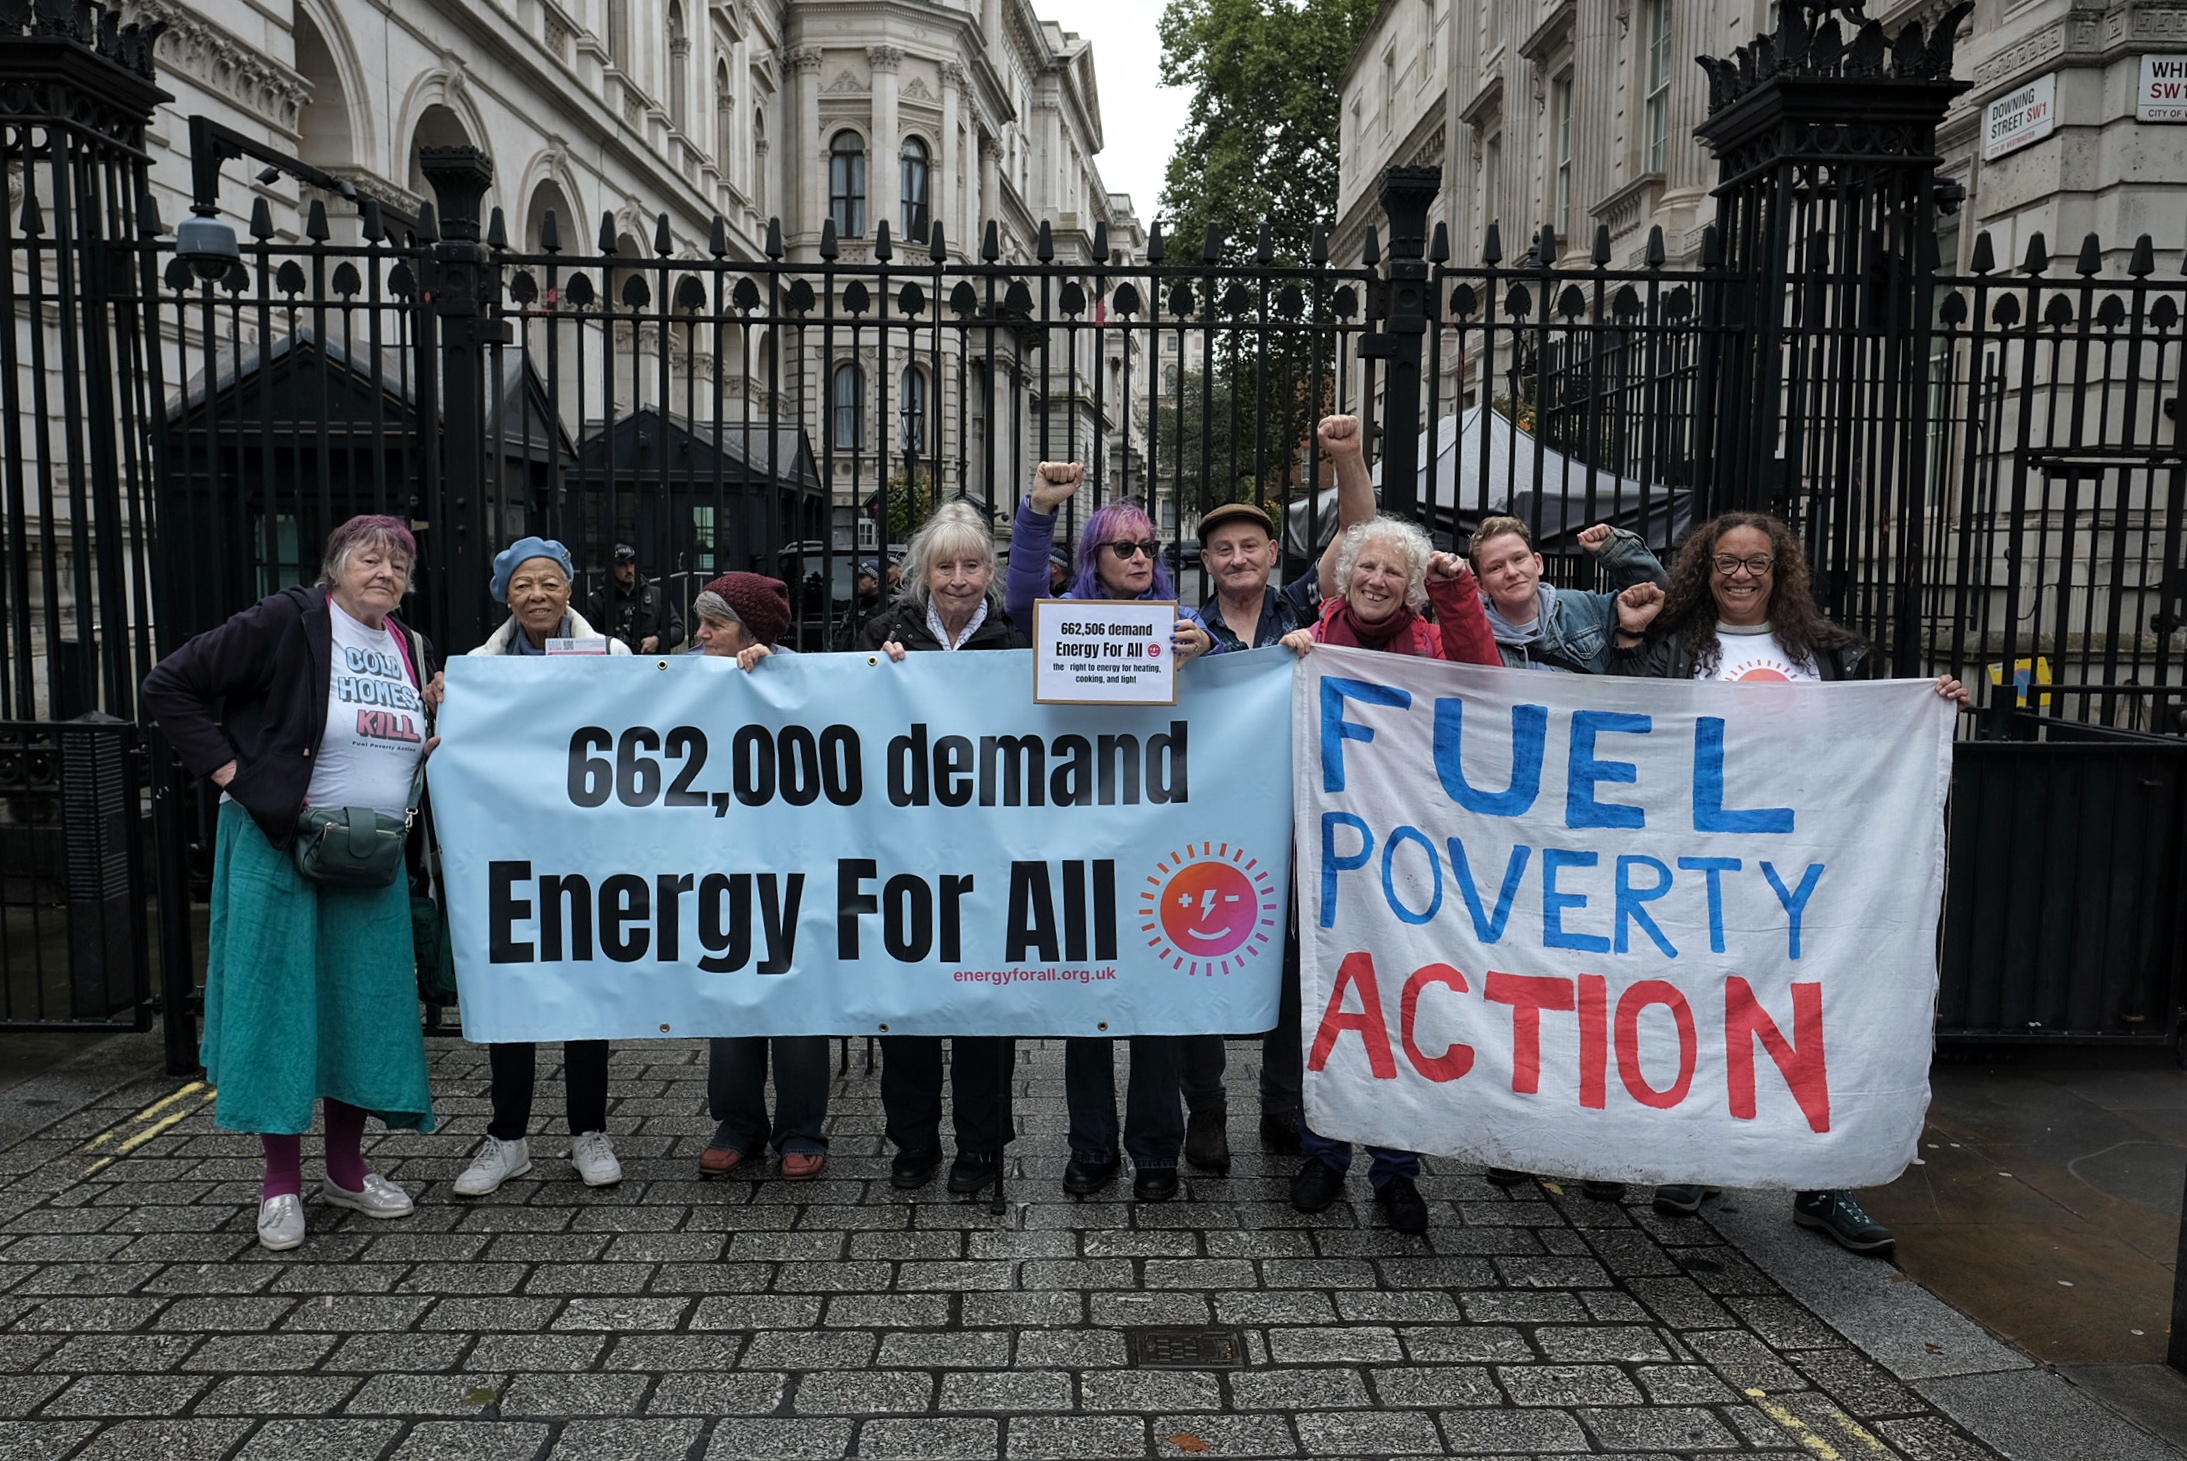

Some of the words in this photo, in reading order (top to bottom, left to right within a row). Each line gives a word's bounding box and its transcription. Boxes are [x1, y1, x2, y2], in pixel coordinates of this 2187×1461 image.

[1991, 111, 2024, 139] STREET
[2026, 101, 2047, 123] SW1
[1992, 87, 2035, 121] DOWNING
[2148, 109, 2168, 117] CITY
[2170, 109, 2182, 117] OF
[1990, 146, 1999, 155] CITY
[1999, 143, 2006, 152] OF
[1061, 622, 1105, 636] 662,506
[1108, 623, 1152, 636] demand
[345, 646, 402, 681] COLD
[1056, 641, 1099, 659] Energy
[1103, 642, 1123, 658] For
[1127, 642, 1143, 658] All
[1053, 663, 1064, 671] the
[1070, 663, 1087, 672] right
[1088, 663, 1095, 671] to
[1096, 664, 1120, 673] energy
[1122, 663, 1131, 672] for
[1133, 664, 1161, 673] heating,
[1075, 675, 1105, 684] cooking,
[1106, 675, 1120, 683] and
[1121, 675, 1137, 684] light
[337, 676, 419, 712] HOMES
[356, 708, 421, 743] KILL
[370, 743, 395, 751] Poverty
[1320, 676, 1796, 835] FUEL
[568, 725, 863, 818] 662,000
[888, 721, 1189, 808] demand
[1320, 812, 1826, 960] POVERTY
[489, 860, 806, 975] Energy
[838, 859, 974, 963] For
[1006, 859, 1118, 963] All
[953, 966, 1117, 986] energyforall.org.uk
[1307, 953, 1830, 1133] ACTION
